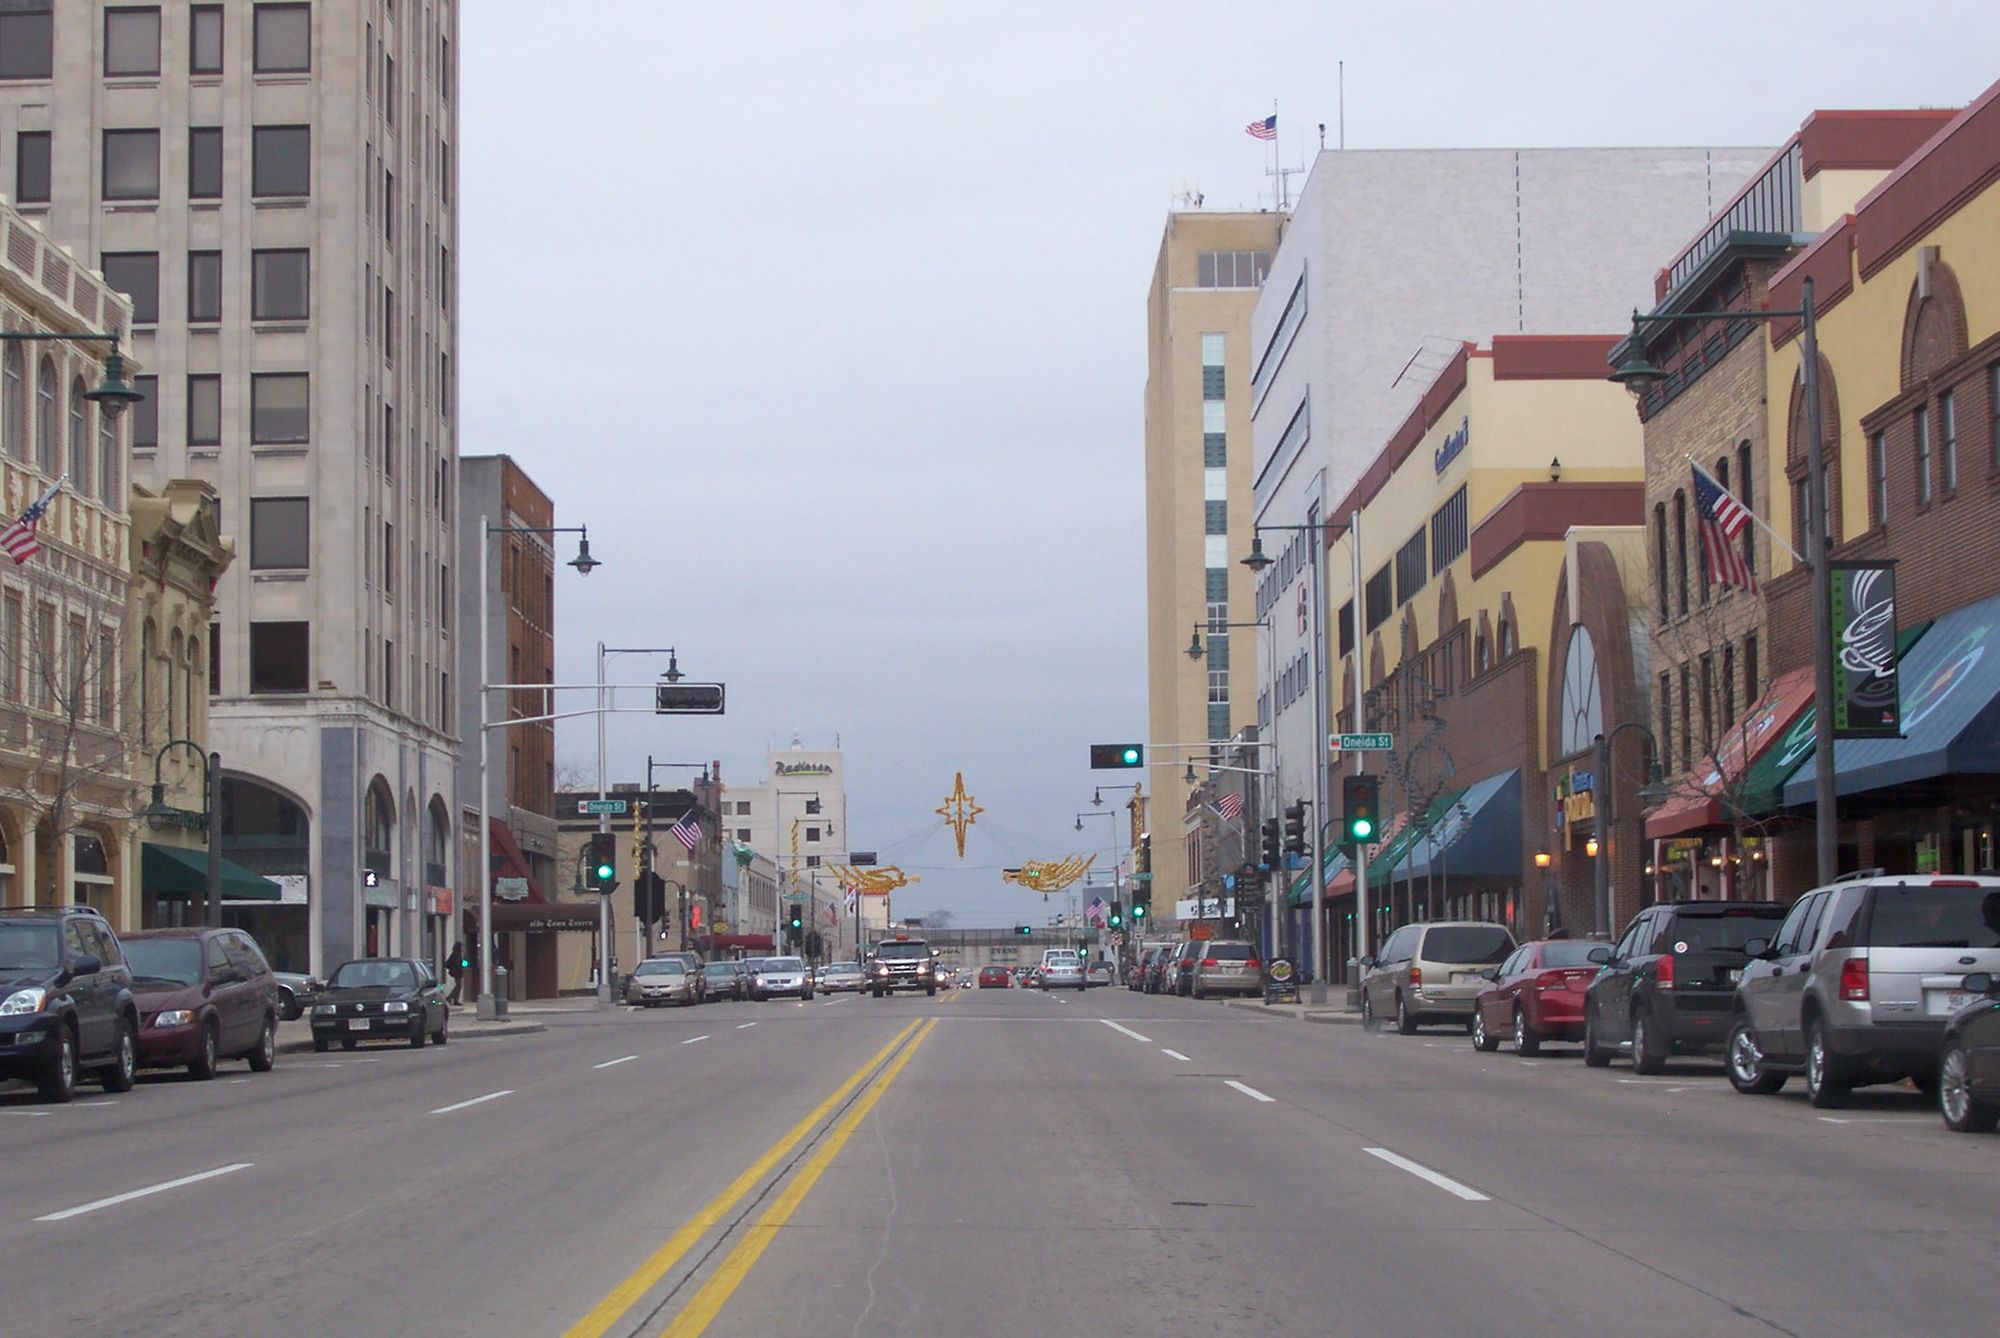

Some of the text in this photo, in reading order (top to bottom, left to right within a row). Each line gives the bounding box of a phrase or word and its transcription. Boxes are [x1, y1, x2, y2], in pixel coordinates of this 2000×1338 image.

[1343, 737, 1388, 747] Oneida St
[589, 802, 623, 812] Oneida St
